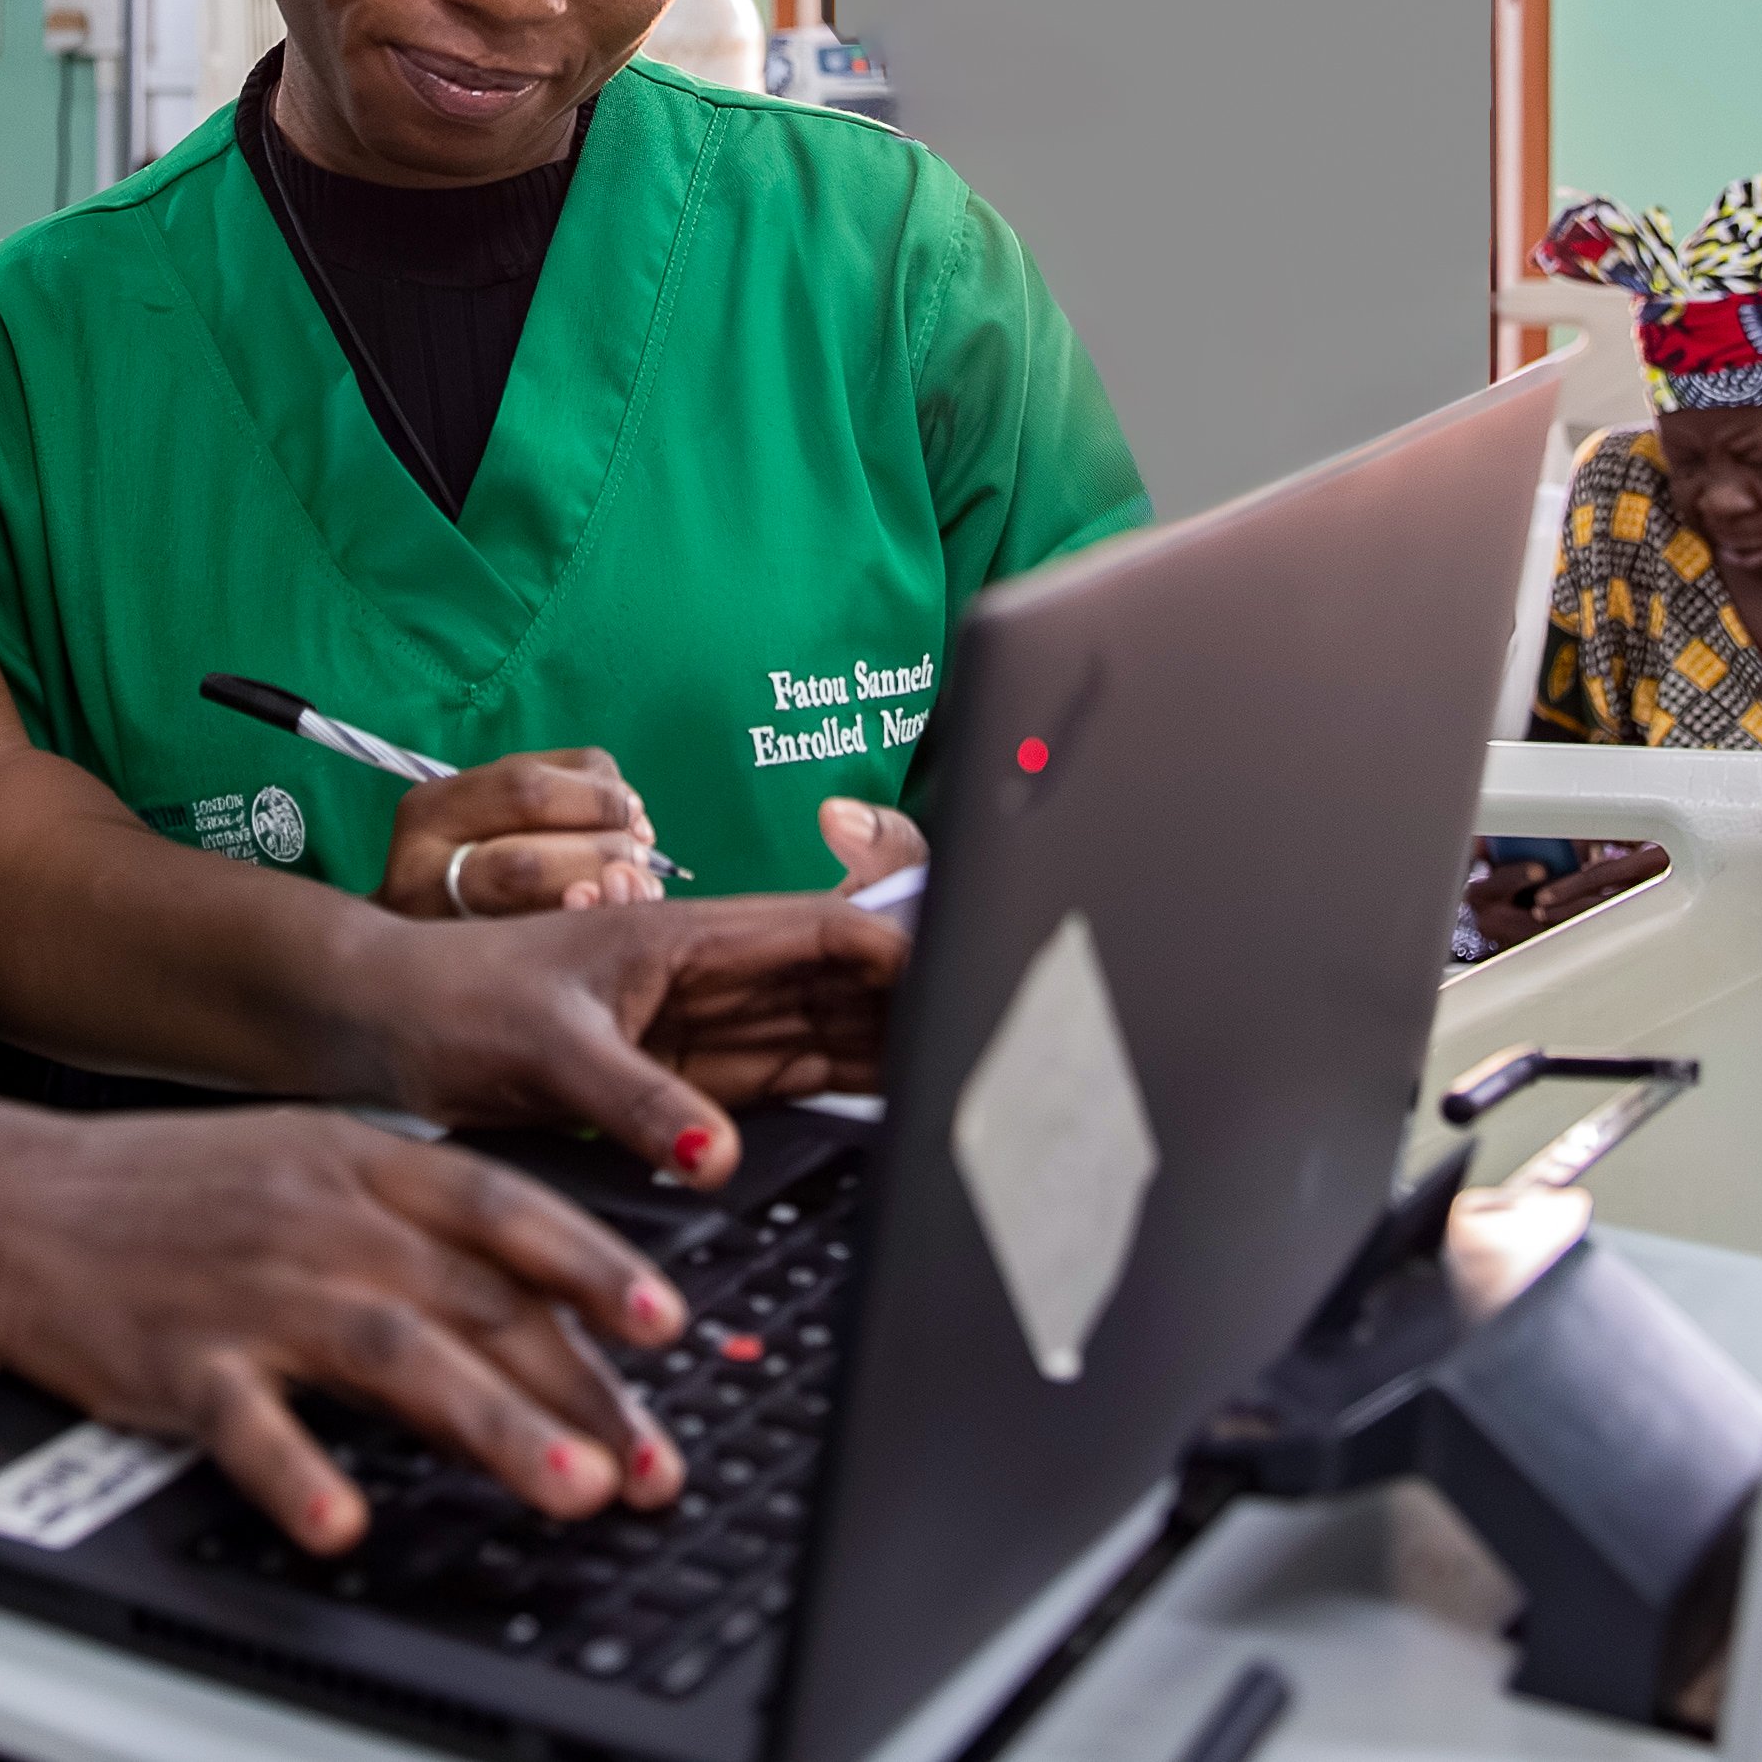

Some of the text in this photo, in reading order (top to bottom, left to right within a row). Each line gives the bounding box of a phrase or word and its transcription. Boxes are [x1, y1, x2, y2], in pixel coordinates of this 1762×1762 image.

[768, 652, 934, 711] Fatou Sanneh
[748, 713, 868, 768] Enrolled
